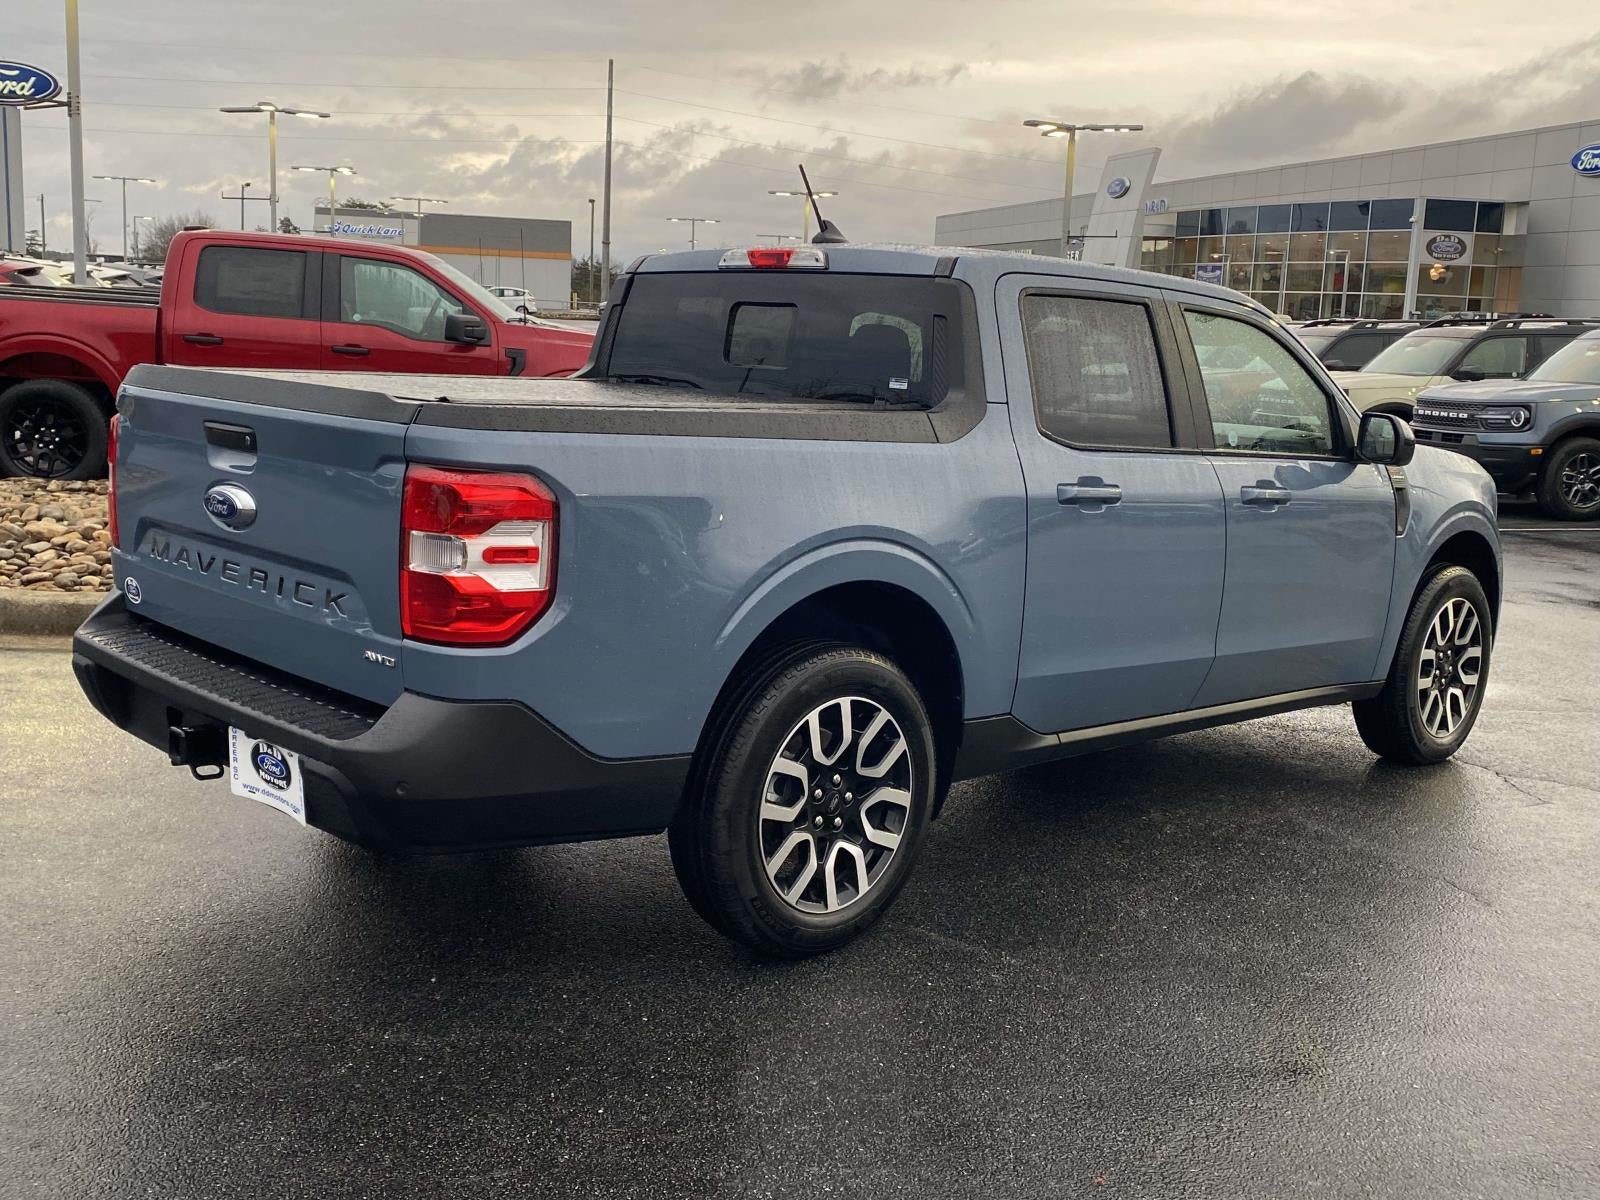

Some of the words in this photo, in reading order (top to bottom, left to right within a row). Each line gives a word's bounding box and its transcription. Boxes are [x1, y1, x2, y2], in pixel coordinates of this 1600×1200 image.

[1577, 149, 1600, 170] For
[342, 224, 374, 234] Quick
[376, 225, 405, 236] Lane
[1418, 409, 1468, 419] BRONCO
[207, 493, 229, 515] Ford
[150, 537, 350, 618] MAVERICK
[363, 650, 396, 668] AWD
[259, 743, 282, 761] D&D
[232, 765, 239, 781] SC
[263, 757, 282, 776] Ford
[259, 768, 288, 790] MOTORS
